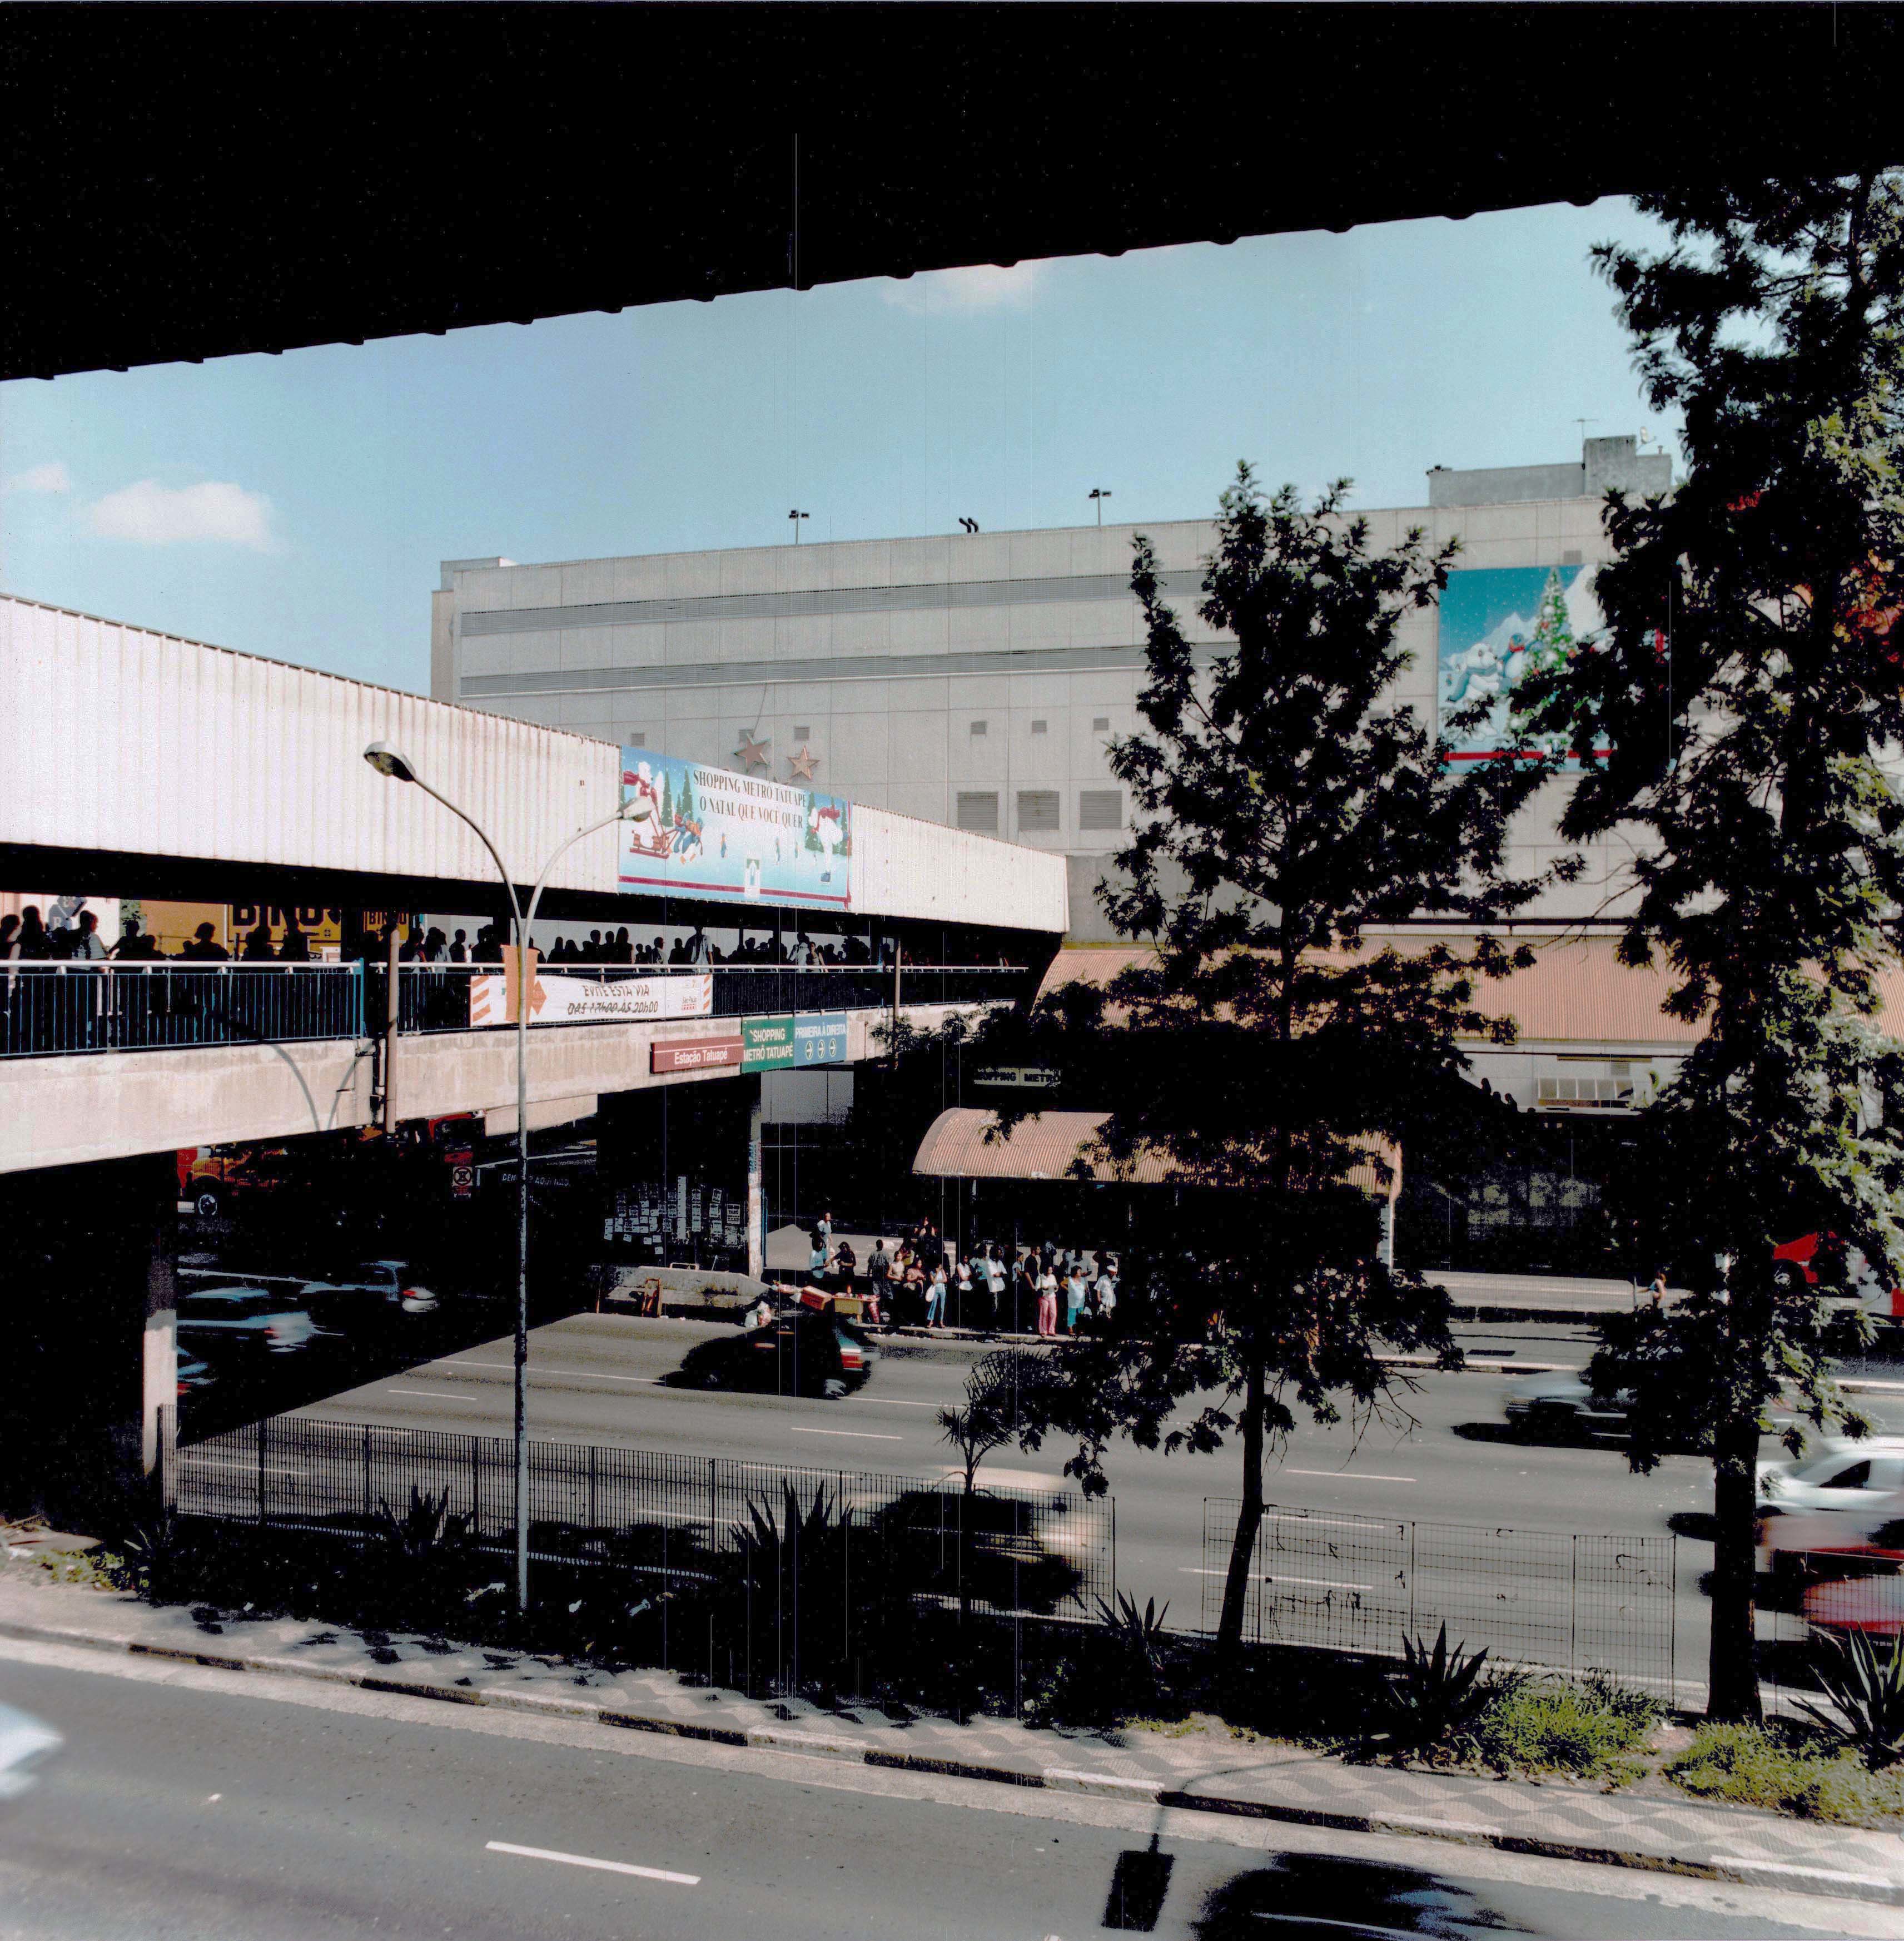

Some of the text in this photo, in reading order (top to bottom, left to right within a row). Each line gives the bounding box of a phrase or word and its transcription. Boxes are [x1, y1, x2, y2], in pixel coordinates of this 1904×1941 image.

[693, 769, 740, 793] SHOPPING
[700, 796, 707, 812] O
[709, 798, 736, 817] NATAL
[738, 803, 756, 821] QUE
[782, 812, 803, 828] QUER
[582, 984, 649, 997] EVITE ESTA VIA
[567, 1002, 587, 1015] DAS
[632, 1001, 659, 1014] 20h00
[753, 1027, 786, 1043] SHOPPING
[674, 1047, 728, 1066] Estação Tatuapé
[743, 1041, 793, 1062] METRÔ TATUAPÉ
